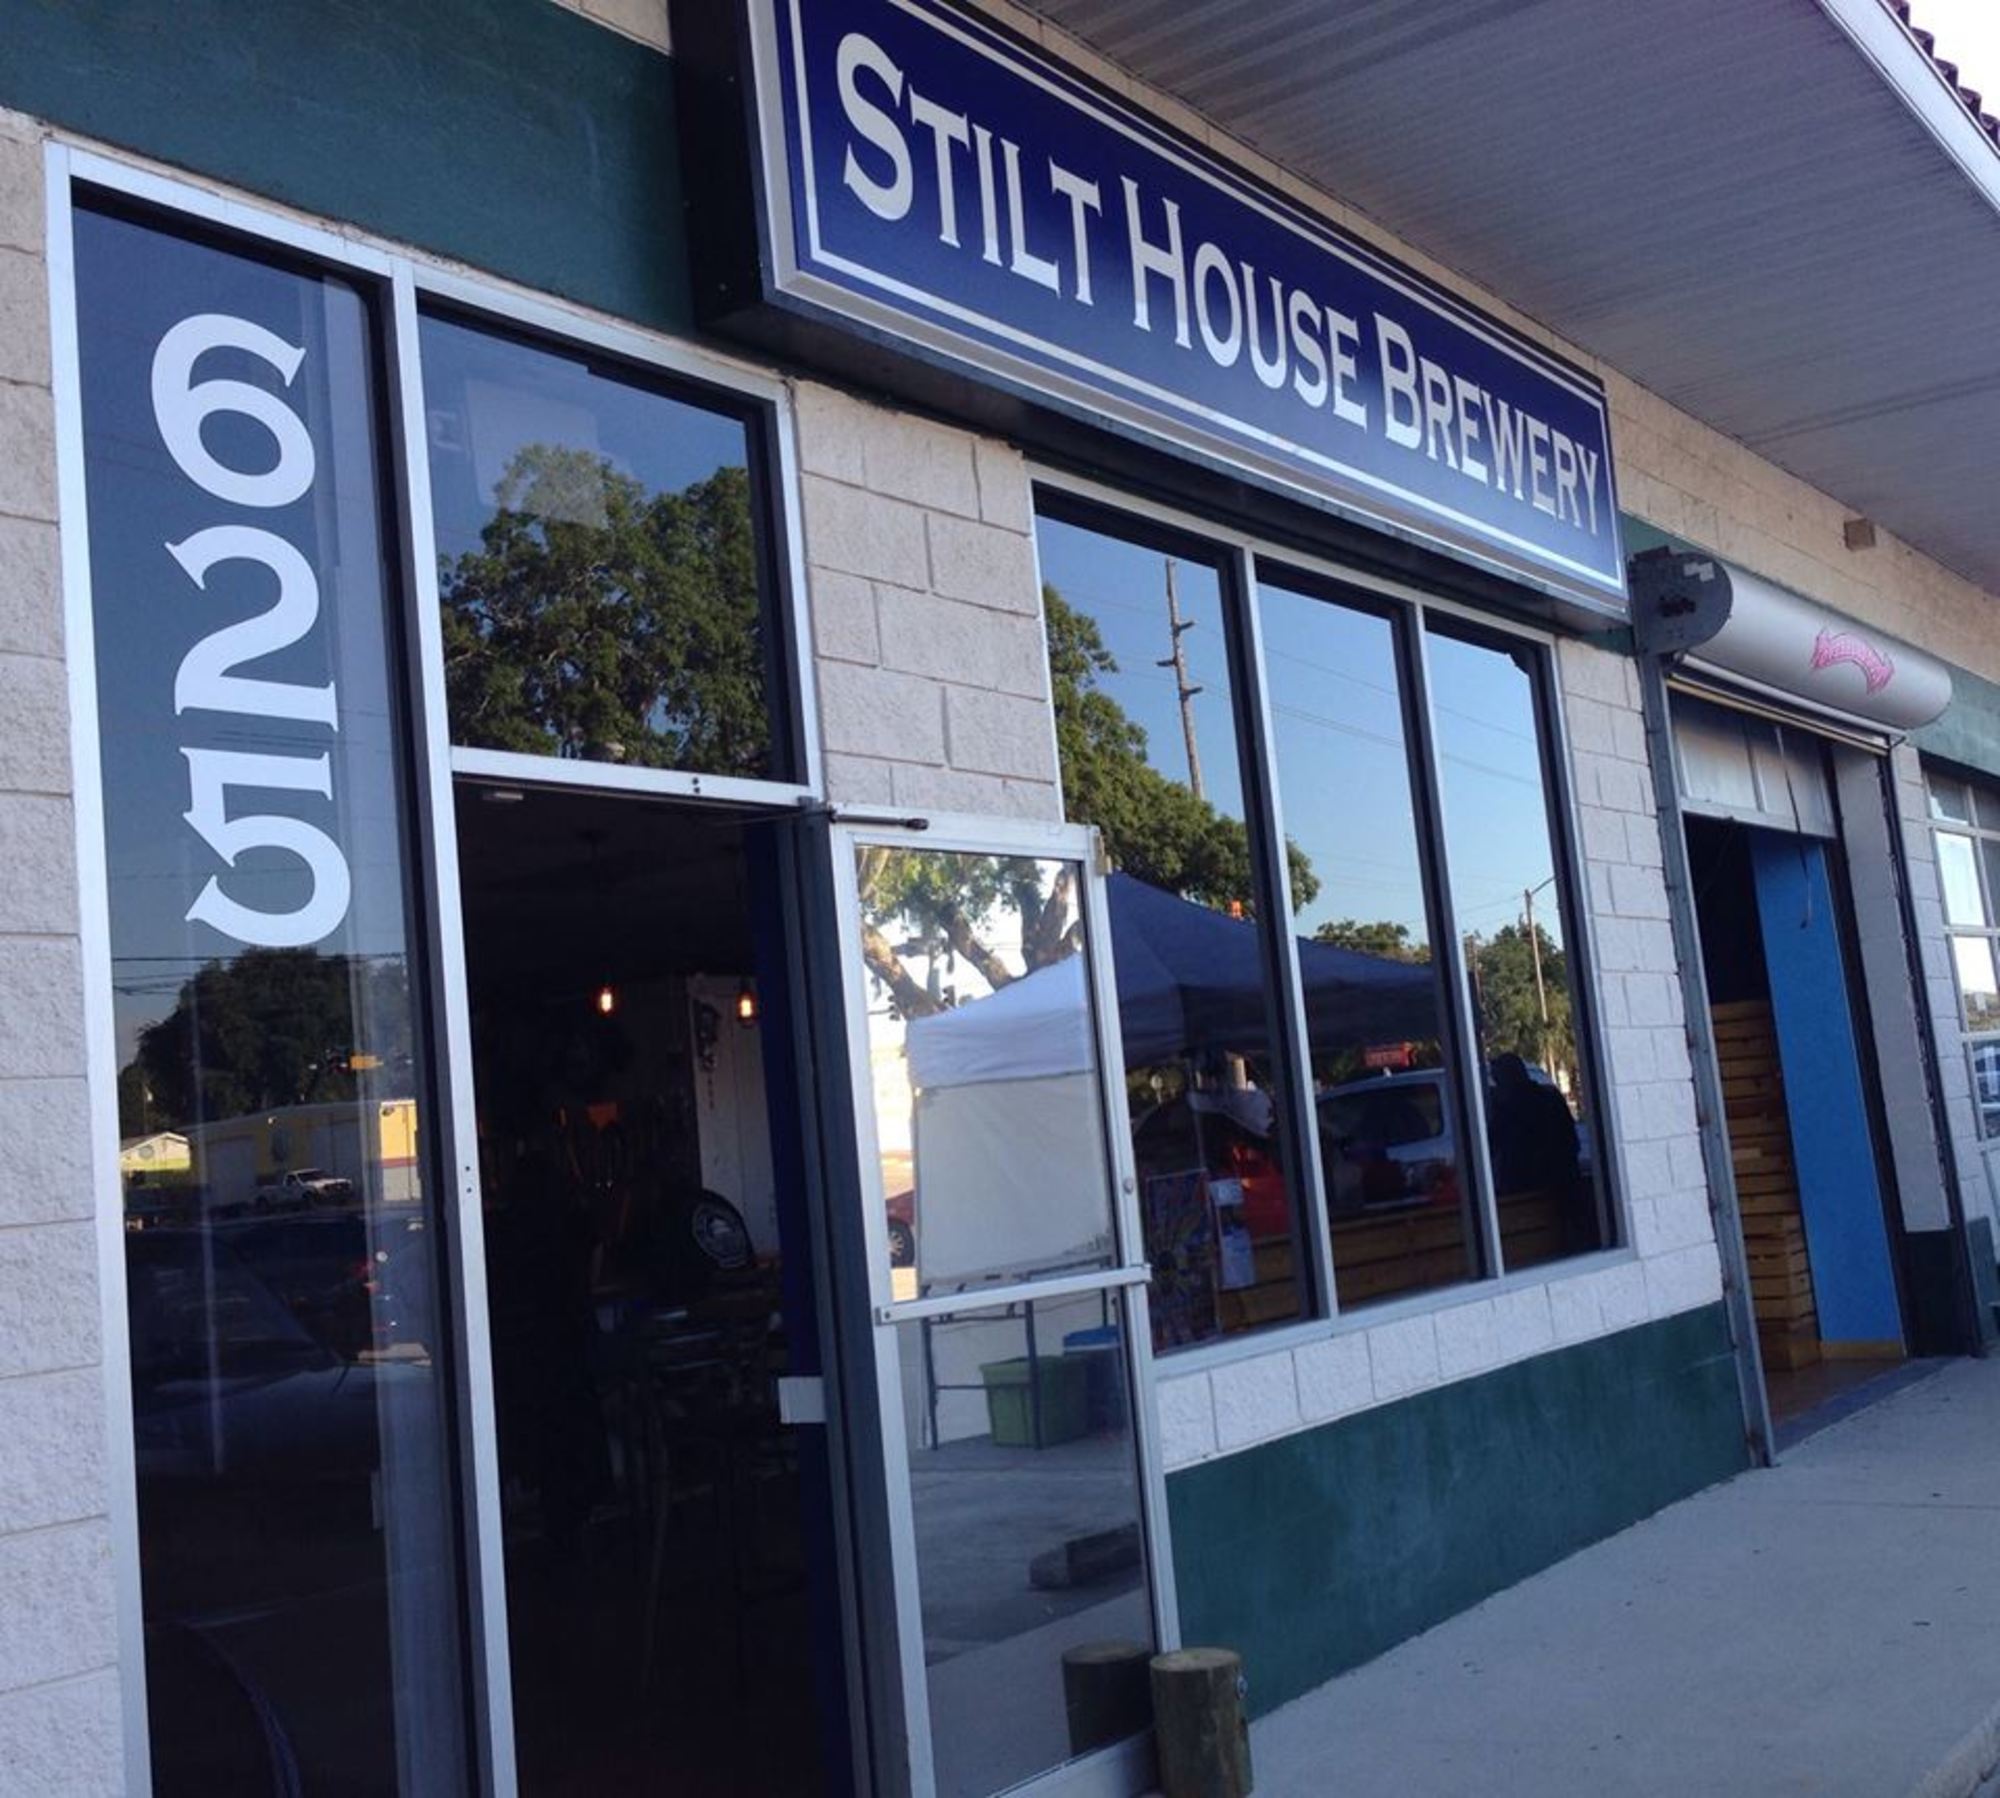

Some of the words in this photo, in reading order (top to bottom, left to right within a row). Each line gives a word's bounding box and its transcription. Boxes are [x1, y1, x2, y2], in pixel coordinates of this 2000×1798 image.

[836, 33, 1103, 305] STILT
[1120, 176, 1368, 430] HOUSE
[1375, 312, 1598, 536] BREWERY
[151, 313, 351, 947] 625
